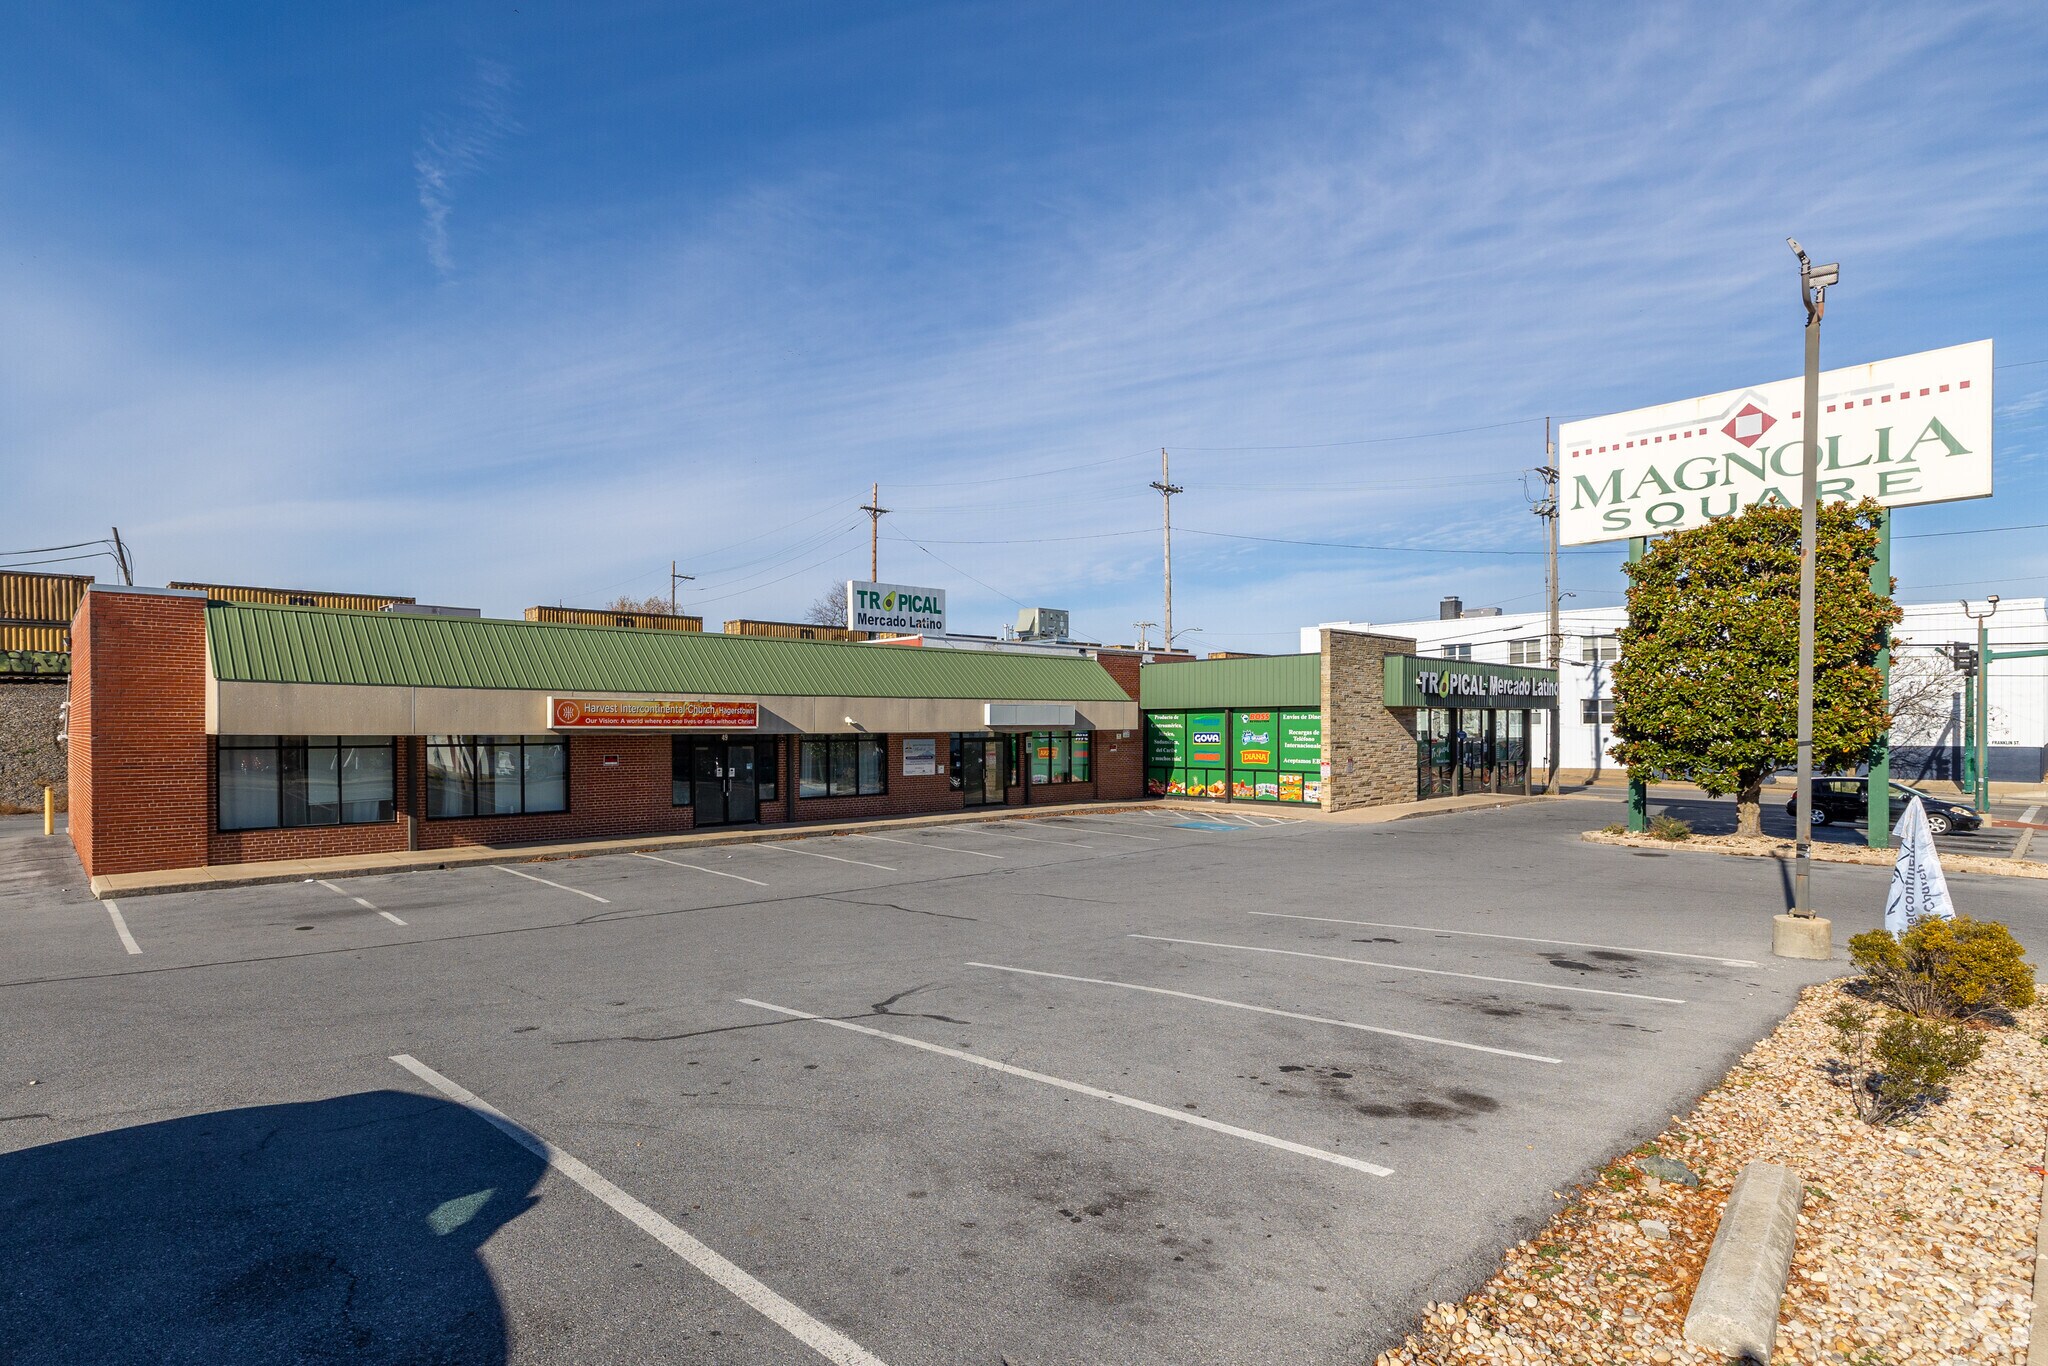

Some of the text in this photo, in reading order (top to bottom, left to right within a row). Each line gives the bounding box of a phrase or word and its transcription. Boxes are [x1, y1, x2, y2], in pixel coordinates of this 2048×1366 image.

[1571, 416, 1972, 511] MAGNOLIA
[1602, 466, 1923, 532] SQUARE
[857, 590, 942, 614] TROPICAL
[857, 613, 942, 630] Mercado Latino
[1419, 670, 1559, 697] TROPICAL Mercado Latino
[584, 702, 618, 713] Harvest
[620, 704, 686, 714] Intercontinental
[719, 707, 754, 716] Hagerstown
[1194, 734, 1220, 743] GOYA
[1918, 864, 1935, 912] Church
